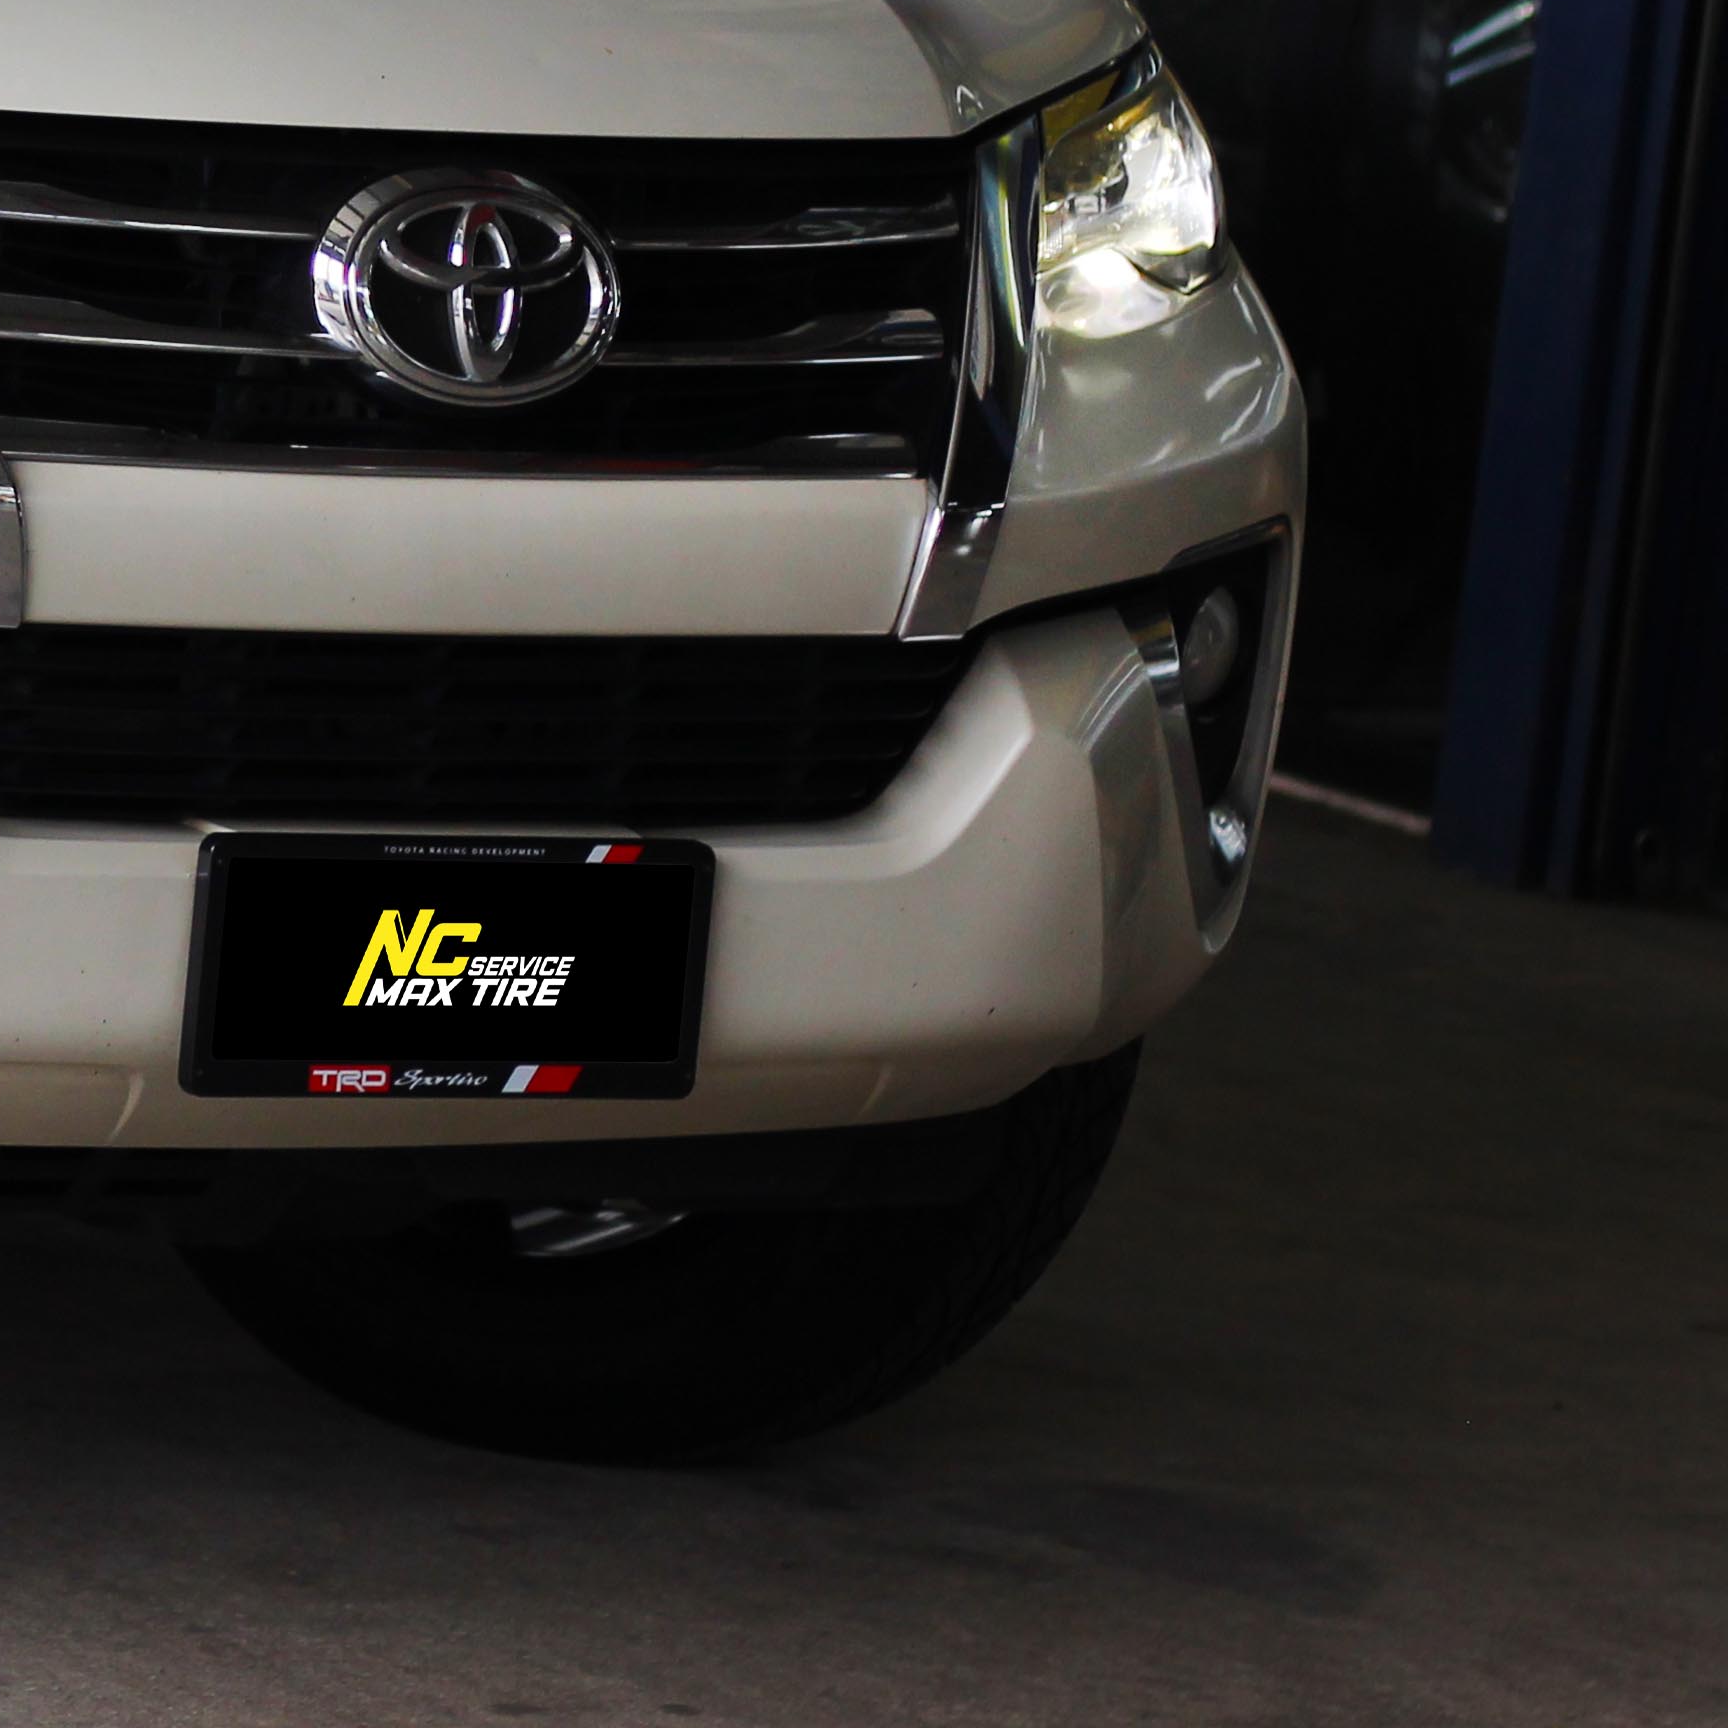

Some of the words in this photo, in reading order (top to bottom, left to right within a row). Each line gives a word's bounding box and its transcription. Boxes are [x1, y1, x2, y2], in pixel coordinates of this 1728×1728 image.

[384, 845, 424, 855] TOYOTA
[429, 846, 467, 856] RACING
[471, 847, 546, 857] DEVELOPMENT
[312, 1069, 387, 1093] TRD
[393, 1068, 489, 1092] Sportivo
